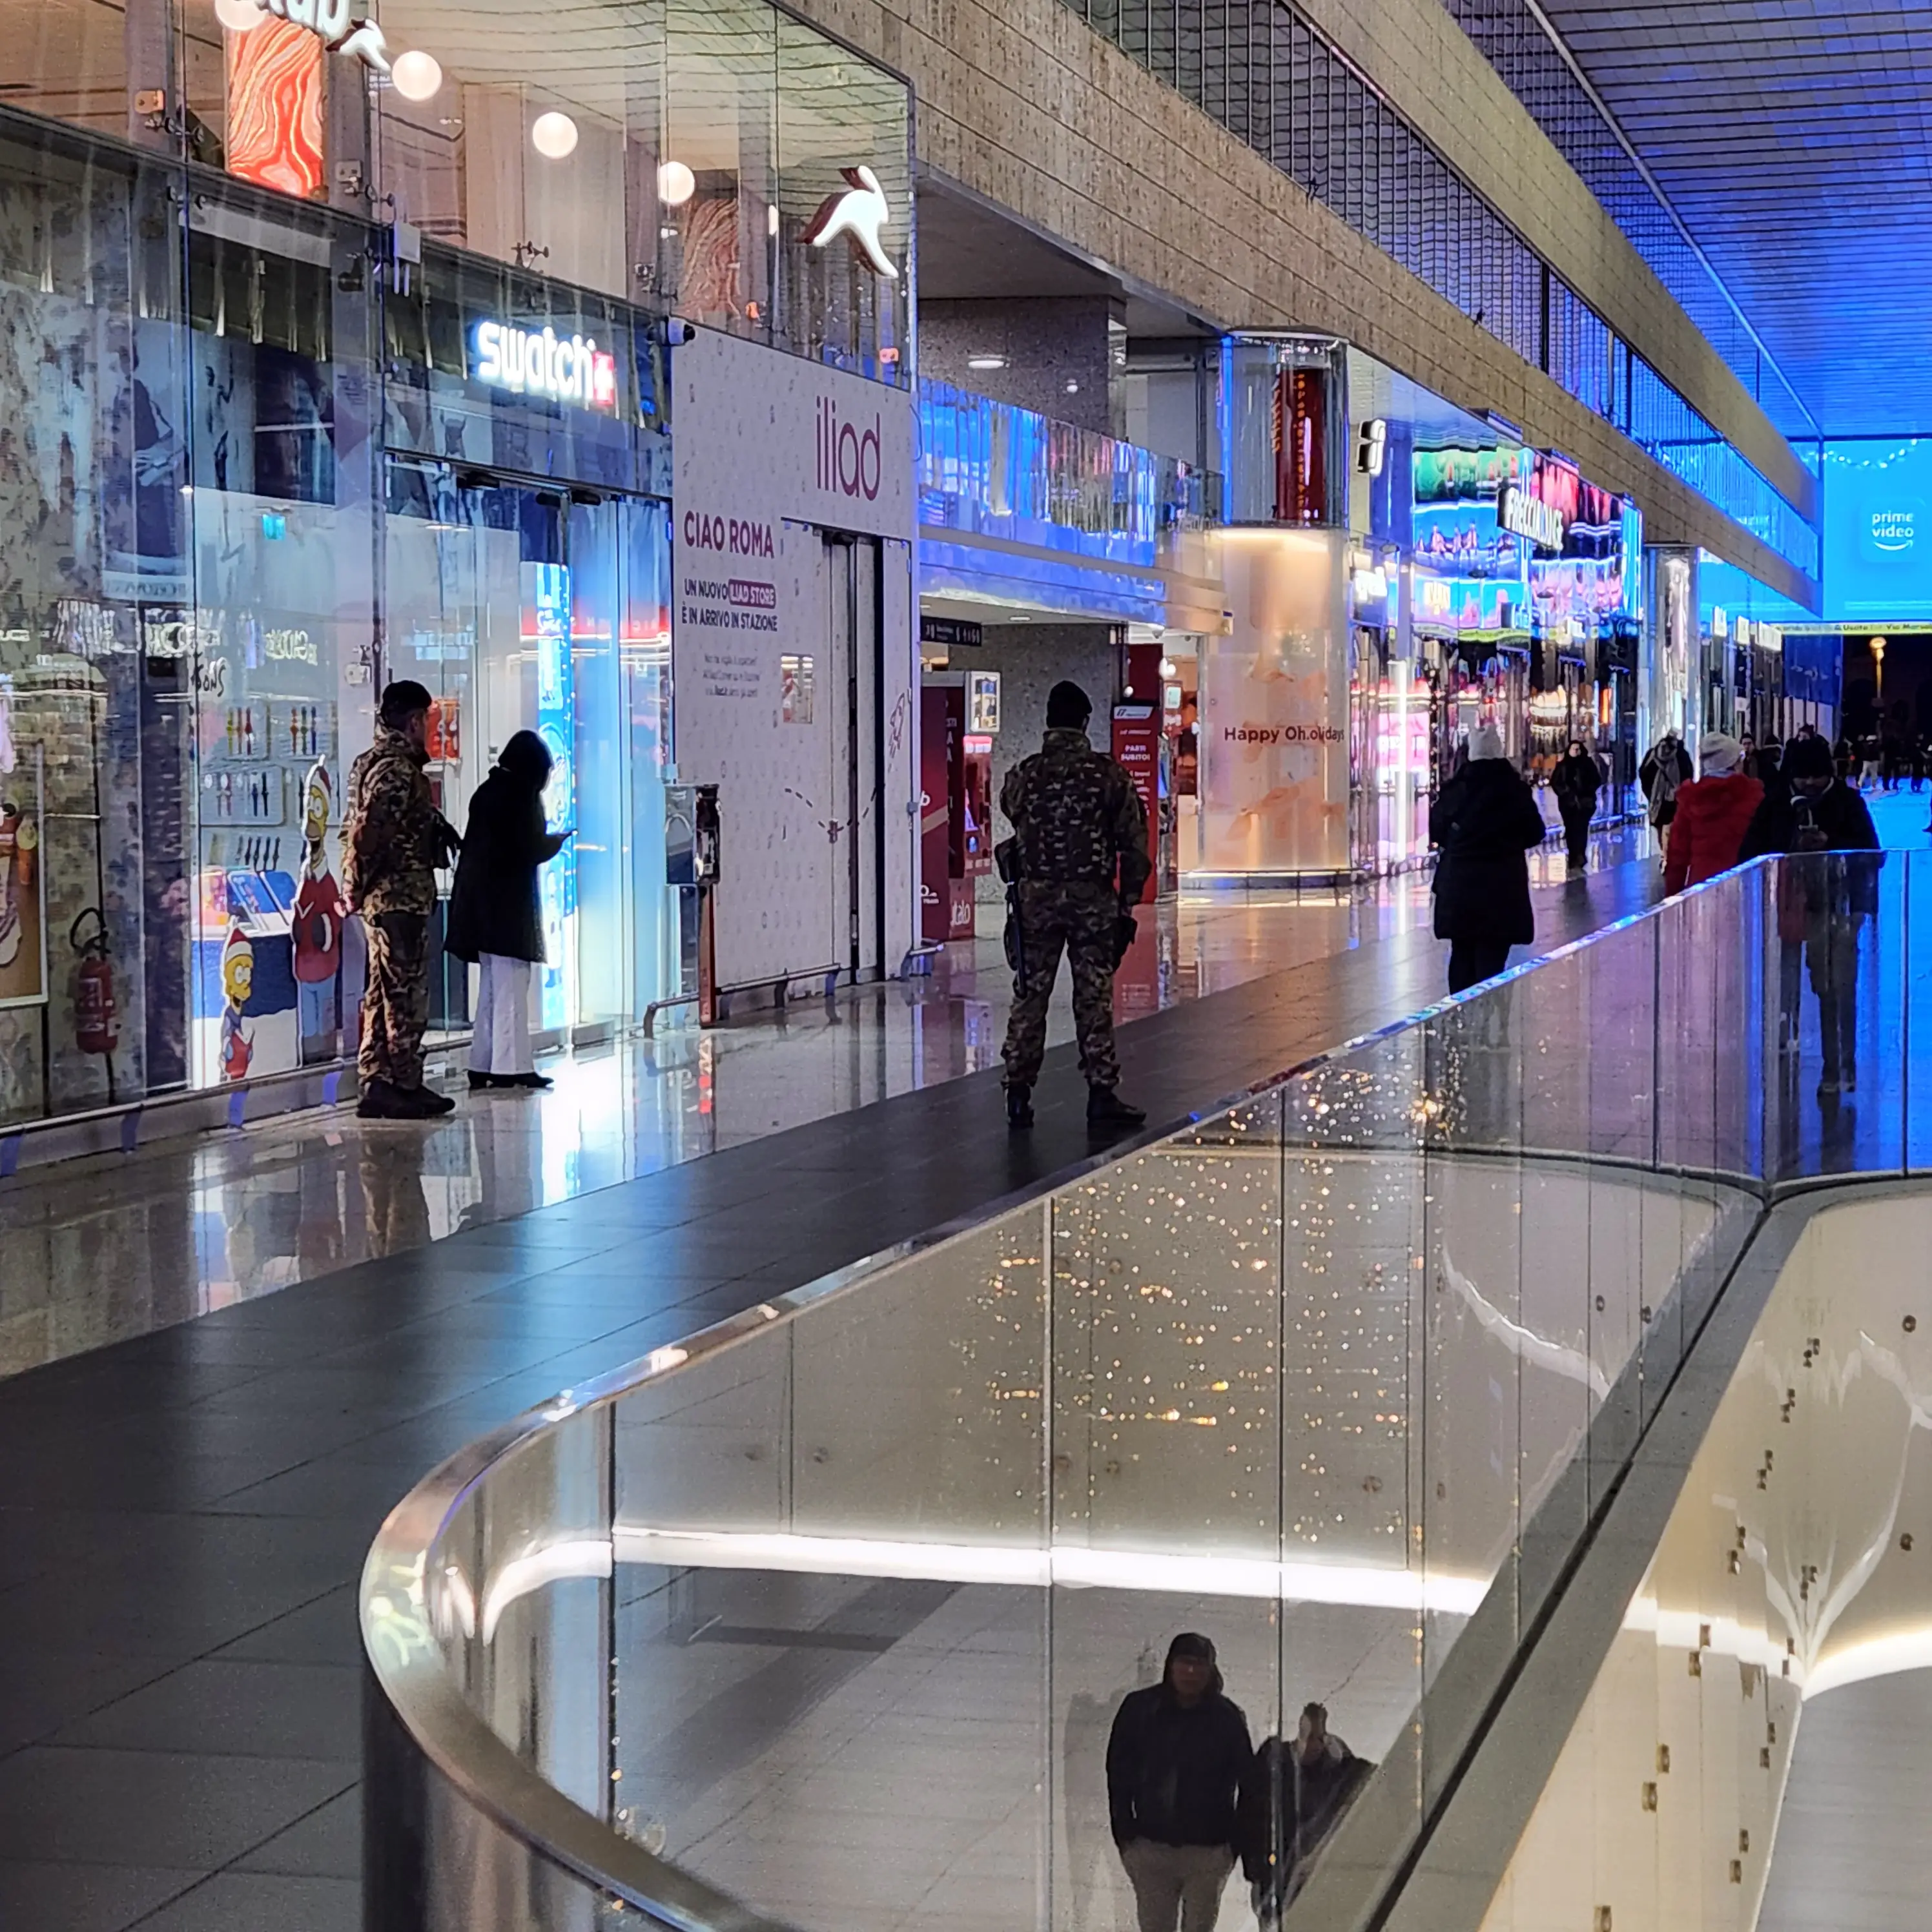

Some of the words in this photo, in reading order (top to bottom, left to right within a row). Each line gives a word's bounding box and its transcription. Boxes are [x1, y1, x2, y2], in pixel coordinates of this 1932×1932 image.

[478, 322, 595, 402] swatch
[816, 395, 880, 501] iliad
[1872, 509, 1914, 526] prime
[684, 510, 725, 551] CIAO
[729, 518, 774, 559] ROMA
[1872, 524, 1914, 537] video
[684, 579, 697, 596] UN
[698, 580, 728, 600] NUOVO
[689, 607, 697, 625] IN
[699, 608, 730, 628] ARRIVO
[731, 611, 739, 628] IN
[1224, 727, 1279, 744] Happy
